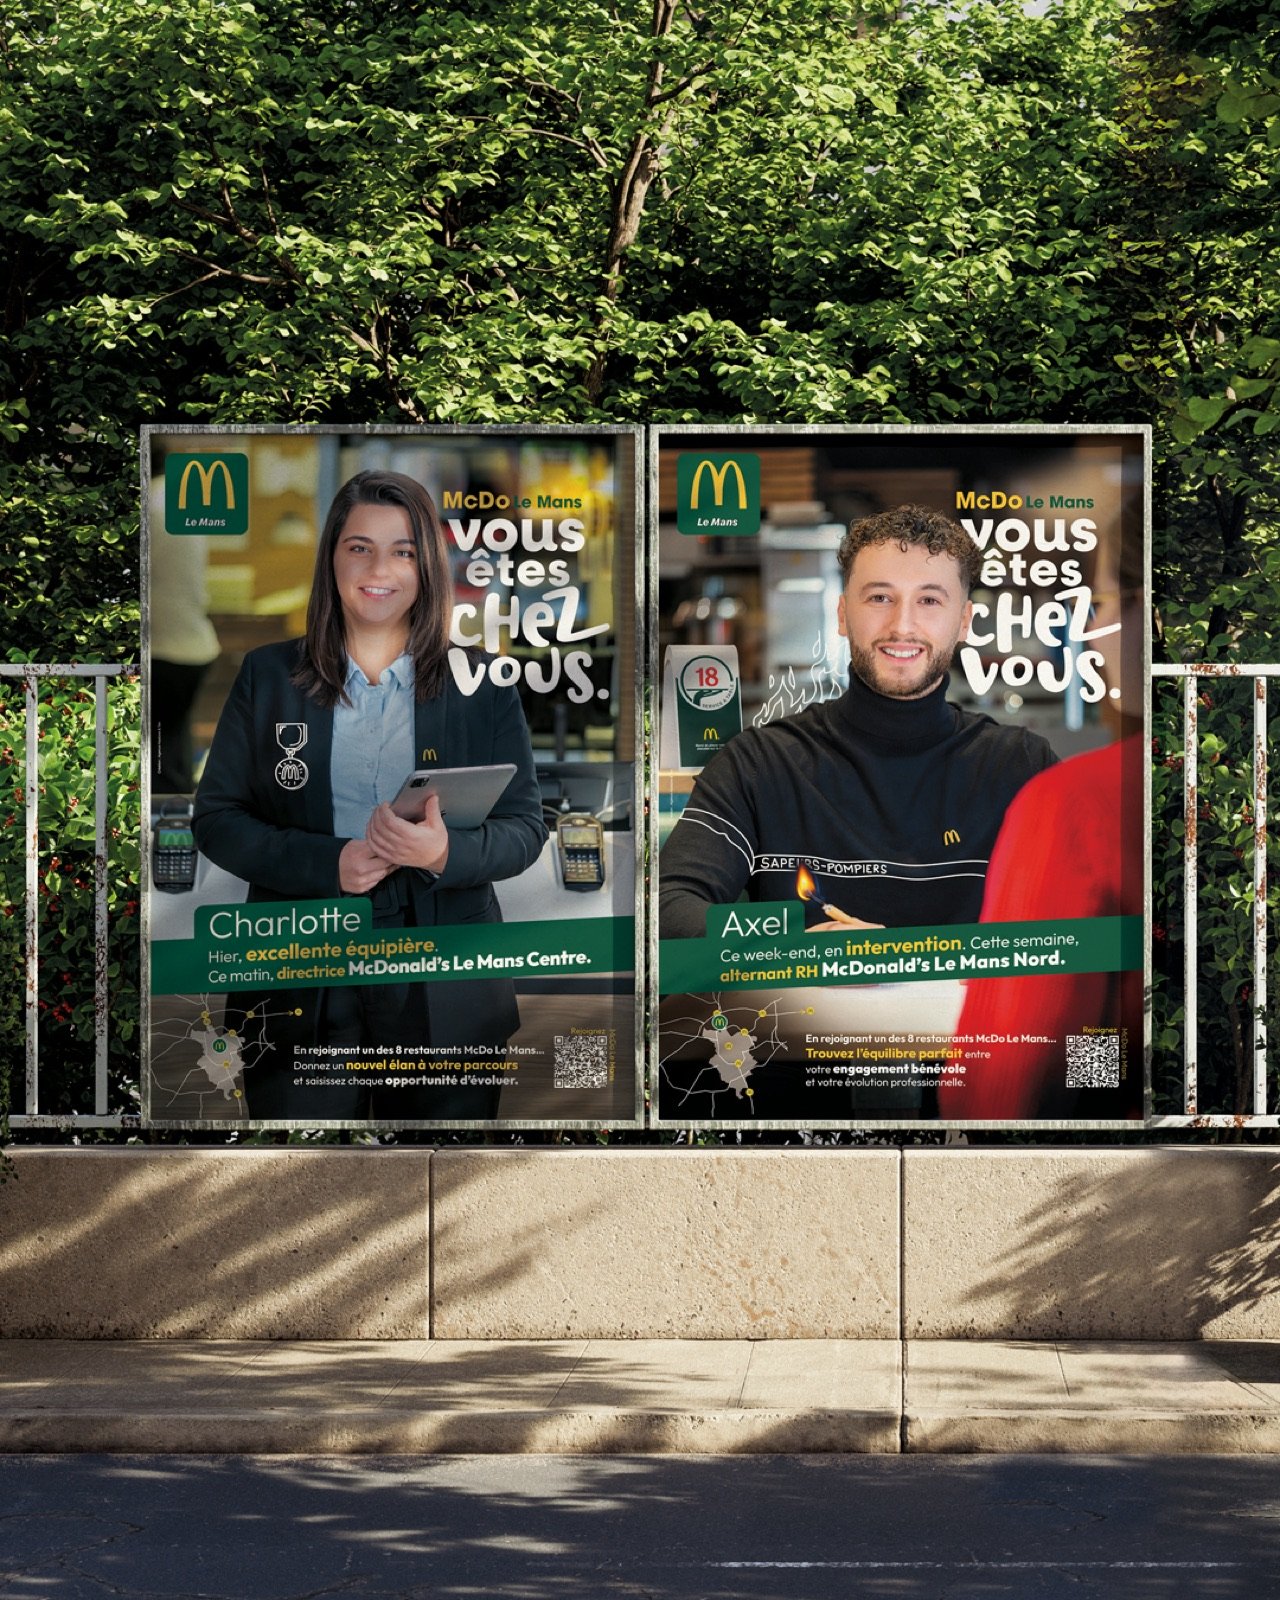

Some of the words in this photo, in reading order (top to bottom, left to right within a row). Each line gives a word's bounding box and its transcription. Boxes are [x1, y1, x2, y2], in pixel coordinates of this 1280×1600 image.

[442, 491, 511, 510] McDo
[514, 496, 531, 509] Le
[537, 496, 582, 509] Mans
[956, 491, 1023, 510] McDo
[1025, 496, 1044, 509] Le
[1049, 496, 1094, 509] Mans
[185, 517, 198, 527] Le
[198, 517, 226, 527] Mans
[697, 517, 710, 527] Le
[710, 517, 738, 527] Mans
[448, 518, 585, 552] vous
[960, 518, 1098, 552] vous
[466, 548, 571, 582] êtes
[980, 548, 1083, 582] êtes
[695, 666, 719, 687] 18
[209, 907, 361, 939] Charlotte
[721, 907, 788, 938] Axel
[208, 950, 243, 964] Hier,
[246, 943, 342, 961] excellente
[345, 936, 439, 960] équipière.
[720, 949, 740, 962] Ce
[743, 946, 821, 961] week-end,
[824, 948, 843, 957] en
[846, 936, 966, 957] intervention.
[970, 935, 1010, 950] Cette
[1013, 932, 1079, 948] semaine,
[208, 970, 227, 983] Ce
[230, 968, 274, 982] matin,
[276, 965, 346, 980] directrice
[453, 955, 474, 971] Le
[477, 953, 525, 970] Mans
[526, 950, 592, 967] Centre.
[720, 967, 792, 982] alternant
[795, 965, 818, 978] RH
[934, 956, 956, 971] Le
[960, 953, 1010, 970] Mans
[1013, 950, 1066, 967] Nord.
[805, 1034, 818, 1043] En
[820, 1034, 872, 1044] rejoignant
[888, 1034, 905, 1043] des
[907, 1034, 914, 1043] 8
[915, 1034, 974, 1043] restaurants
[976, 1034, 1006, 1043] McDo
[1007, 1034, 1019, 1043] Le
[1082, 1026, 1118, 1034] Rejoignez
[293, 1045, 307, 1055] En
[308, 1045, 360, 1056] rejoignant
[362, 1047, 374, 1055] un
[376, 1045, 393, 1055] des
[395, 1045, 402, 1055] 8
[403, 1045, 462, 1055] restaurants
[464, 1045, 494, 1055] McDo
[495, 1045, 507, 1055] Le
[806, 1048, 853, 1059] Trouvez
[919, 1047, 963, 1060] parfait
[965, 1049, 991, 1059] entre
[293, 1061, 330, 1070] Donnez
[346, 1059, 386, 1070] nouvel
[389, 1059, 416, 1070] élan
[418, 1059, 426, 1070] à
[428, 1061, 461, 1070] votre
[463, 1061, 518, 1073] parcours
[805, 1065, 831, 1074] votre
[833, 1064, 909, 1076] engagement
[911, 1063, 966, 1074] bénévole
[293, 1076, 303, 1085] et
[305, 1075, 346, 1085] saisissez
[348, 1075, 383, 1087] chaque
[385, 1074, 458, 1087] opportunité
[805, 1078, 816, 1087] et
[818, 1078, 843, 1087] votre
[845, 1077, 889, 1087] évolution
[891, 1077, 966, 1088] professionnelle.
